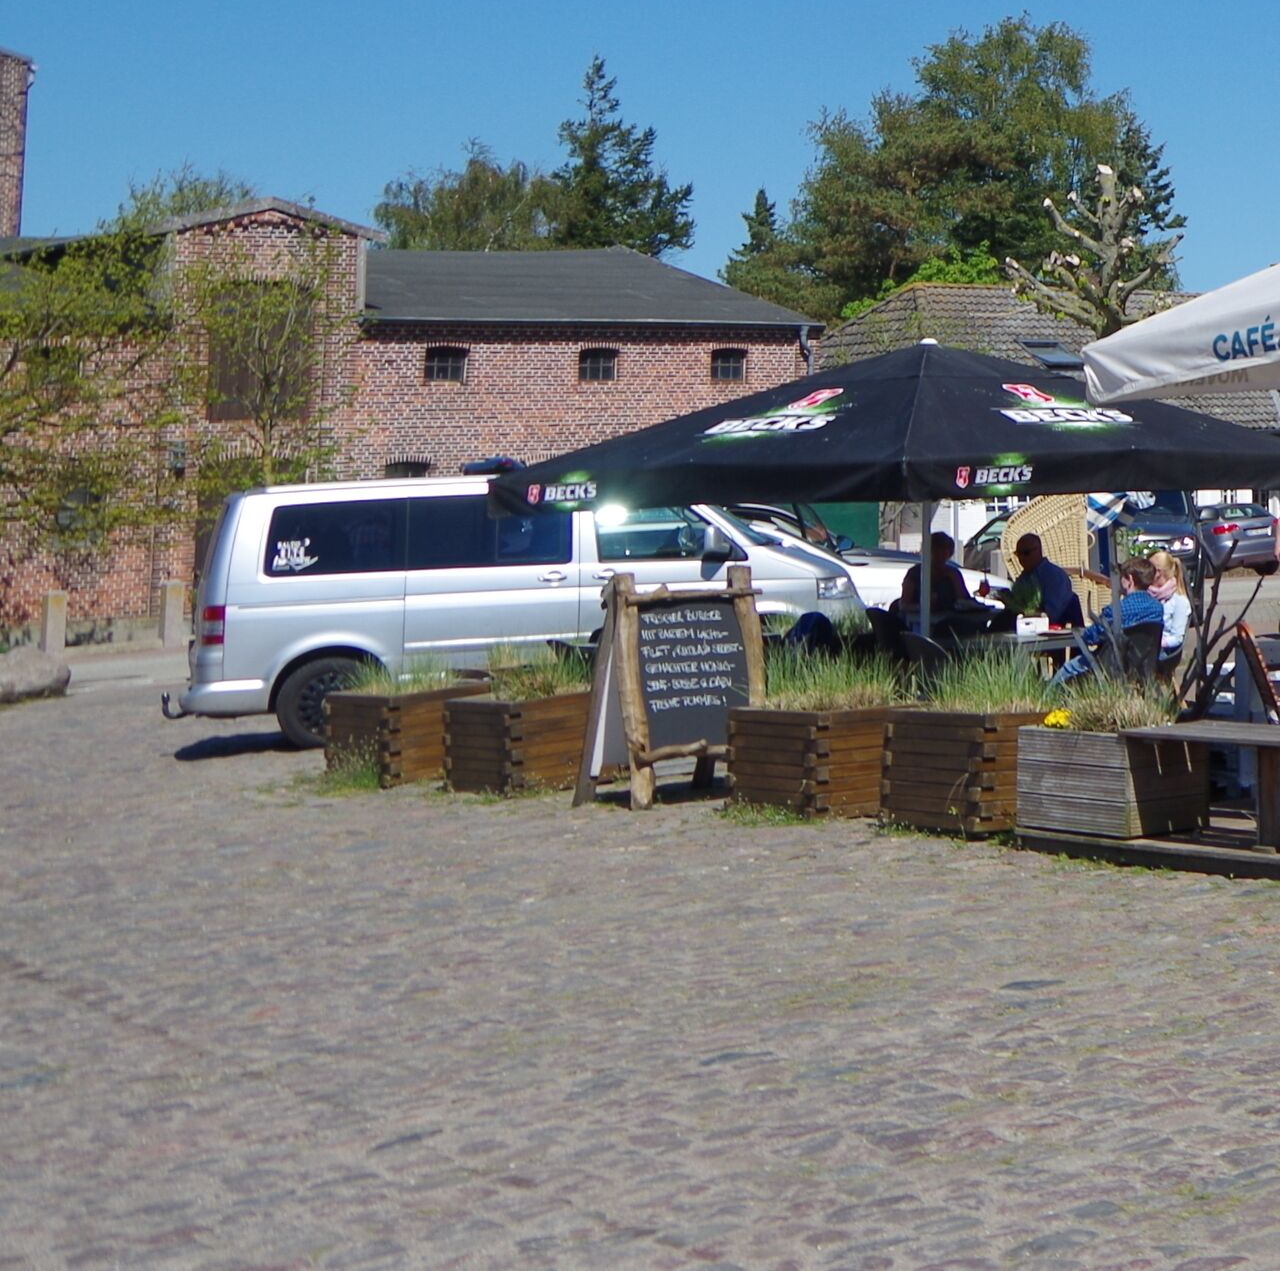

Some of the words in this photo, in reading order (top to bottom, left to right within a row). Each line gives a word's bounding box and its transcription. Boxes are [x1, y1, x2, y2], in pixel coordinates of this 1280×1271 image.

[1212, 314, 1277, 361] CAFÉ
[975, 465, 1033, 483] BECK'S
[544, 482, 597, 501] BECK'S
[685, 609, 722, 622] BURGER
